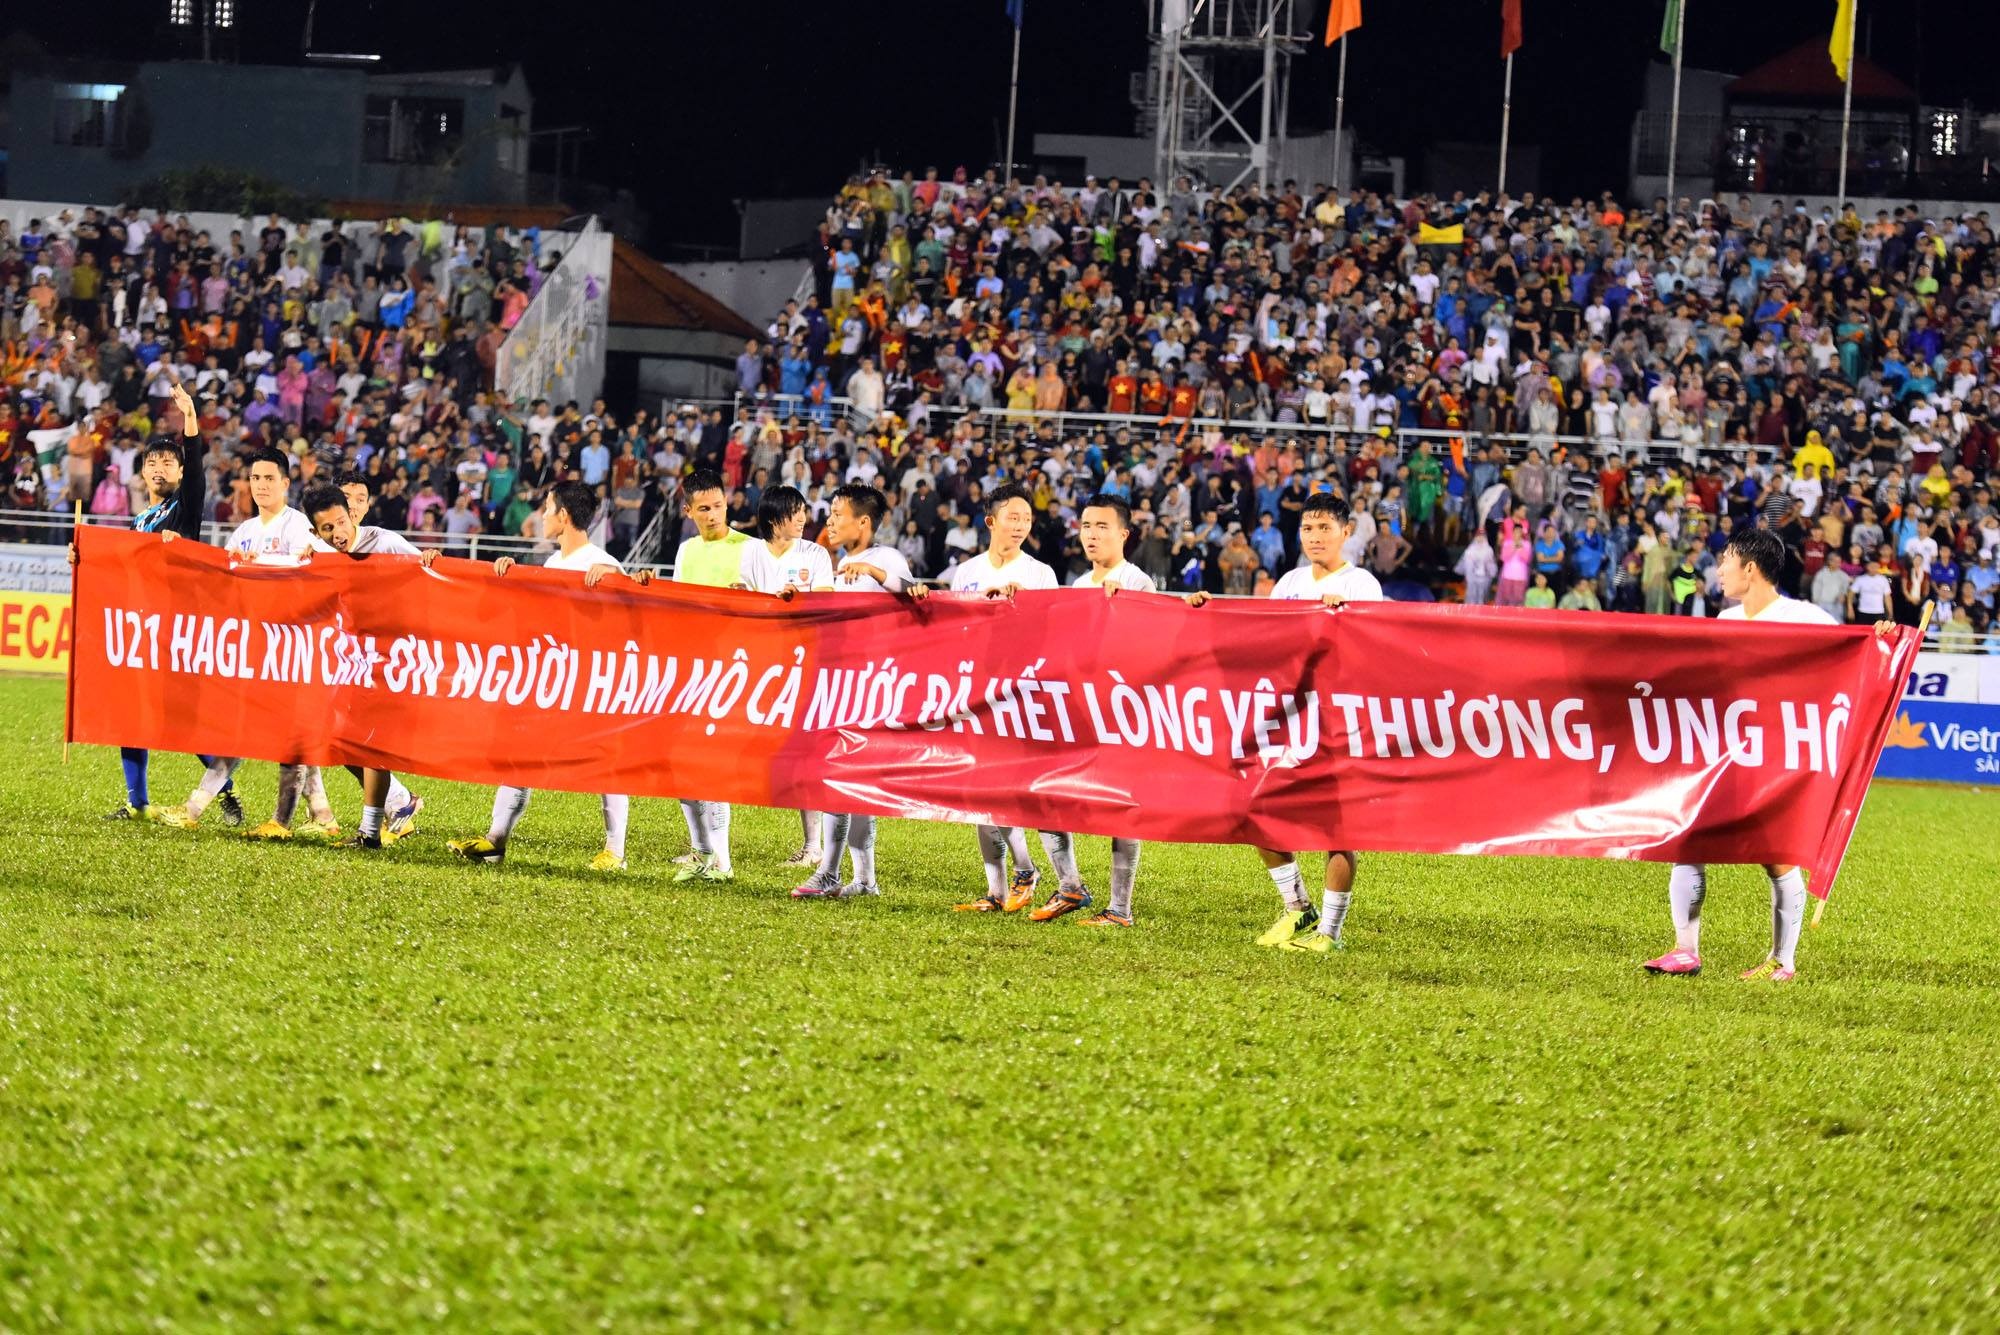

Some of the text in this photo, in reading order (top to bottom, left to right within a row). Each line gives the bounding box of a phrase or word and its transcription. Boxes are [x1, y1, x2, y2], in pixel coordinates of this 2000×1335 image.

[104, 608, 161, 670] U21
[170, 613, 254, 679] HAGL
[261, 621, 314, 684] XIN
[384, 634, 444, 697] ƠN
[448, 635, 579, 711] NGƯỜI
[583, 640, 677, 714] HÂM
[670, 648, 748, 736] MỘ
[746, 645, 806, 728] CẢ
[803, 658, 917, 731] NƯỚC
[917, 660, 984, 735] ĐÃ
[985, 658, 1075, 742] HẾT
[1083, 670, 1213, 756] LÒNG
[1219, 678, 1319, 762] YÊU
[1331, 690, 1616, 773] THƯƠNG,
[1628, 681, 1763, 767] ỦNG
